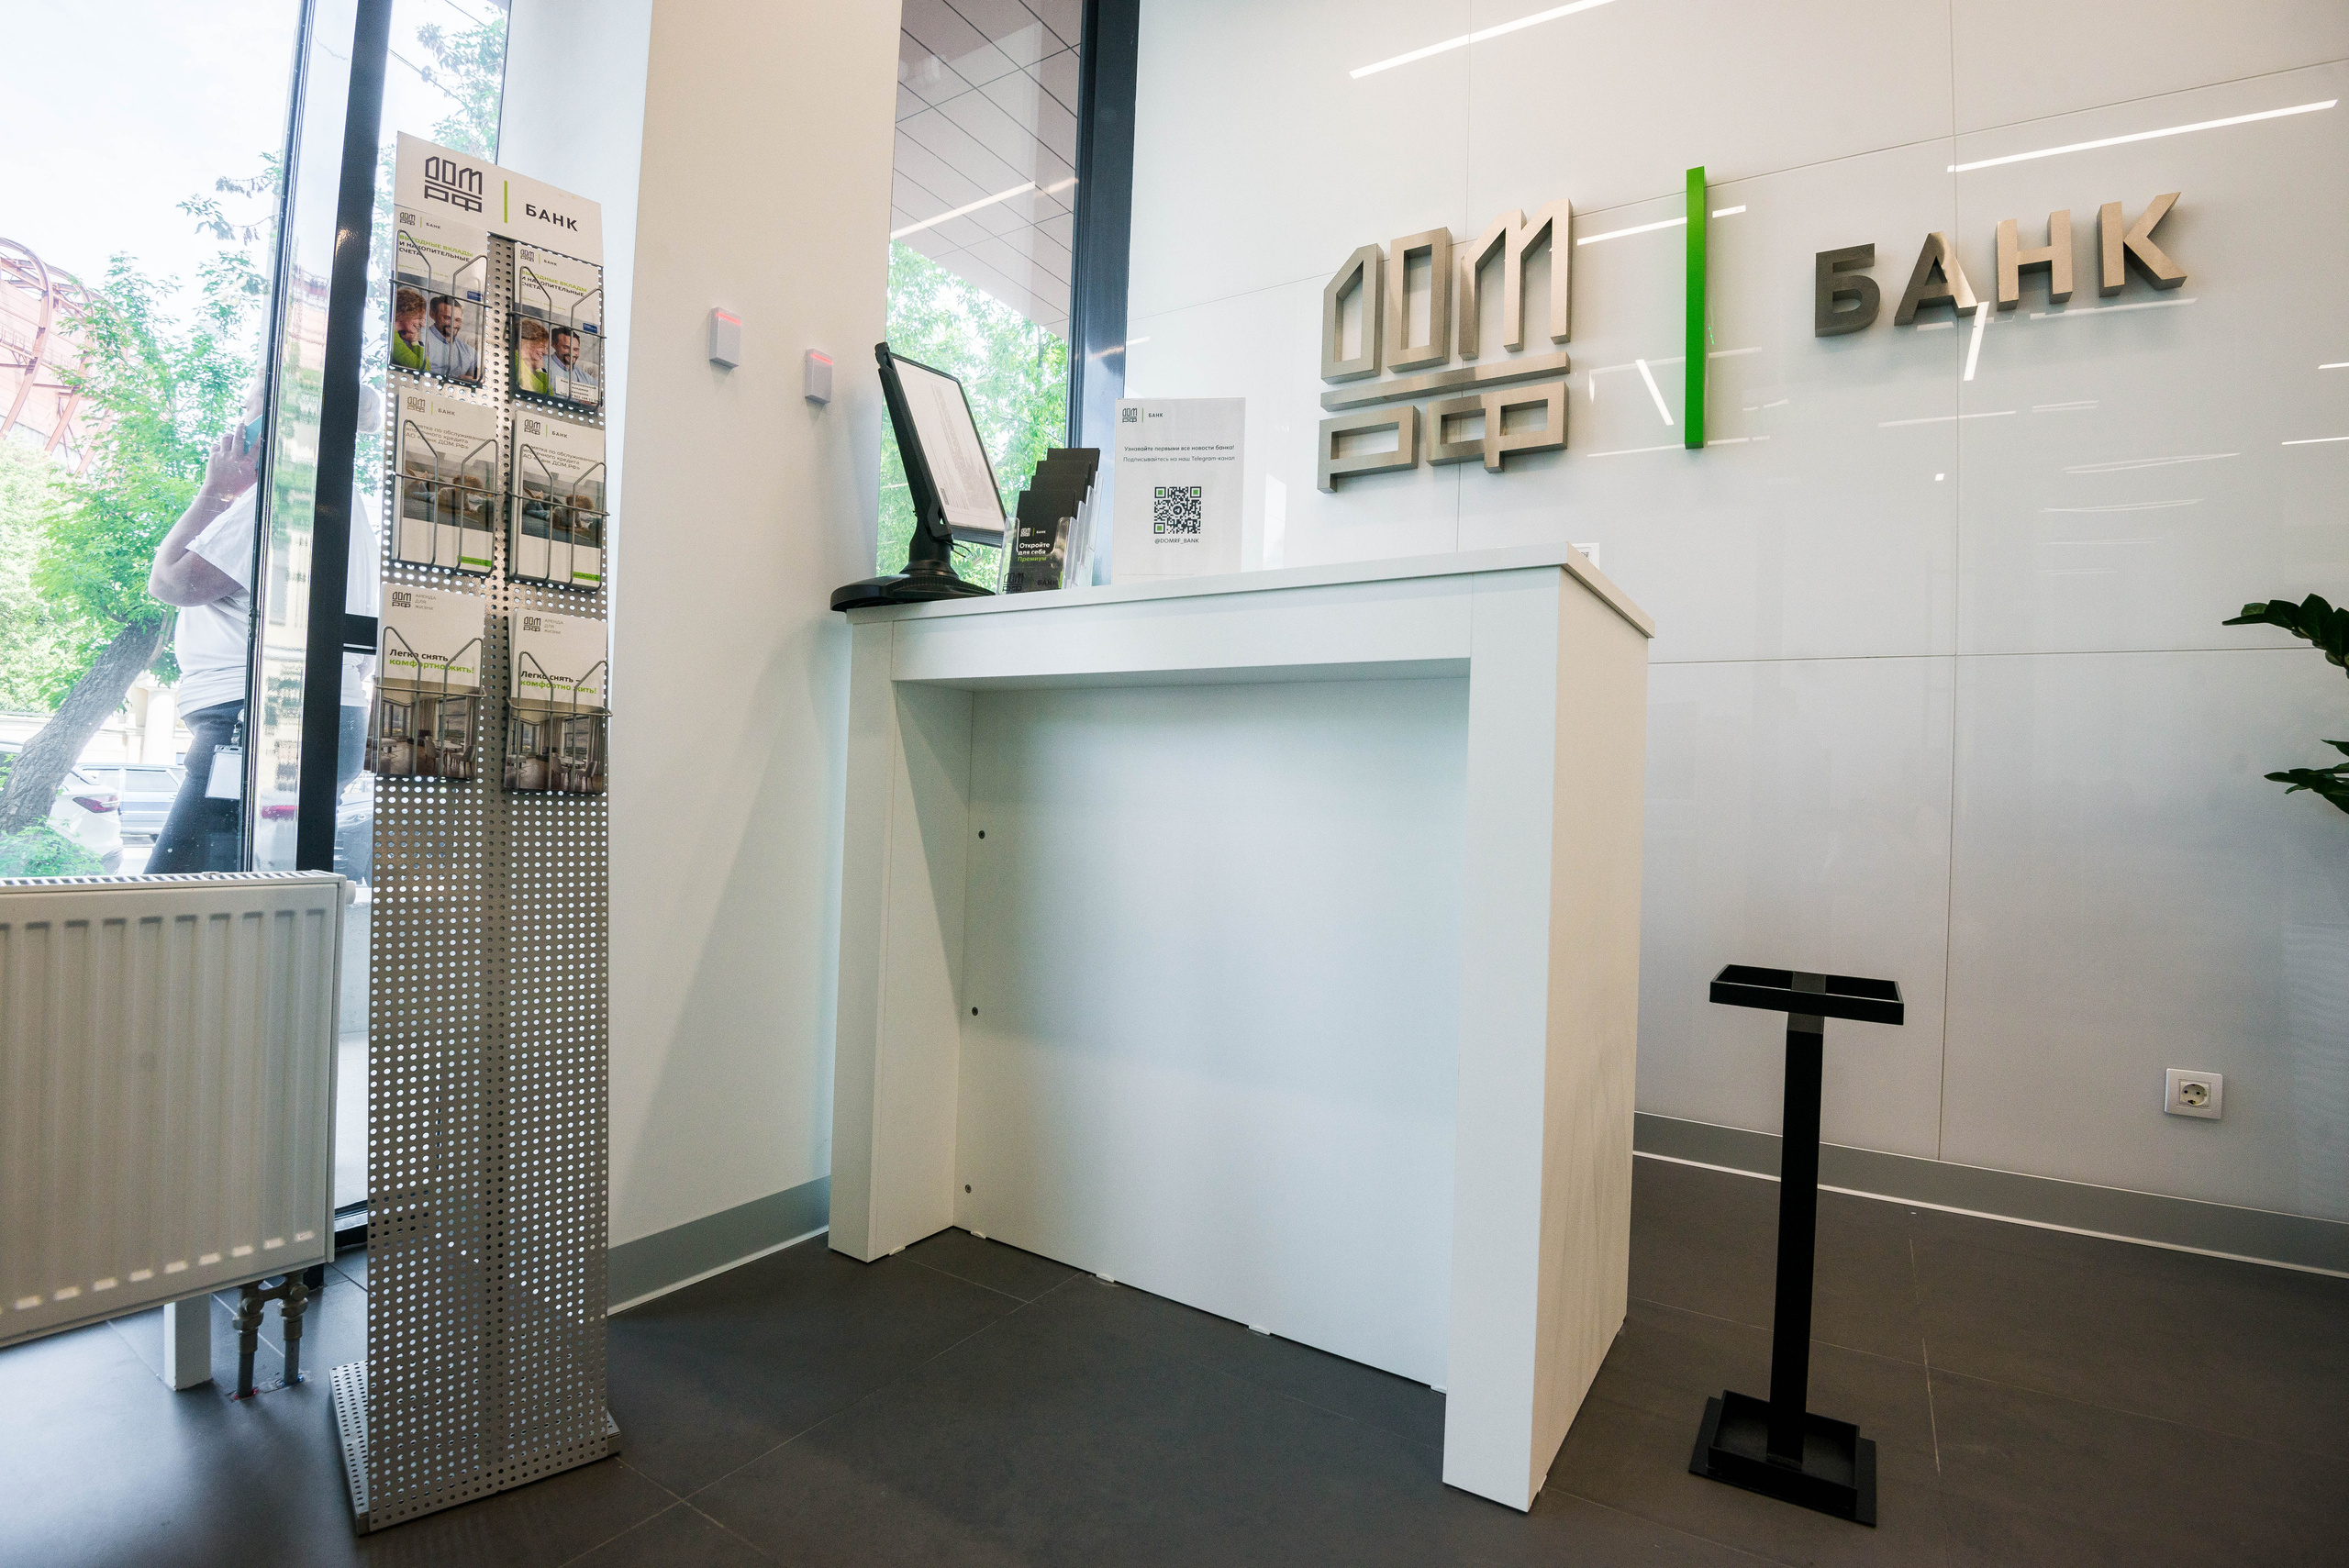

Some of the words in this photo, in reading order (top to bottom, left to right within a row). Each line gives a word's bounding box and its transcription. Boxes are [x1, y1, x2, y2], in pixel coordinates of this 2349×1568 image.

[425, 155, 483, 195] ДОМ
[424, 184, 483, 213] РФ
[525, 203, 578, 232] БАНК
[442, 245, 473, 258] ВКЛАДЫ
[1814, 190, 2188, 339] БАНК
[521, 270, 559, 285] ВЫОДНЫЕ
[559, 281, 587, 293] ВКЛАДЫ
[527, 277, 586, 298] НАОПИТЕЛЬНЫЕ
[1319, 197, 1574, 385] ДОМ
[438, 407, 456, 417] БАНК
[406, 427, 441, 439] ипоечного
[443, 435, 469, 446] кредита
[551, 430, 568, 439] БАНК
[1316, 381, 1569, 495] РФ
[522, 449, 556, 460] ипоечного
[556, 456, 580, 465] кредита
[1019, 541, 1051, 550] Откройте
[392, 591, 412, 602] ДОМ
[523, 616, 541, 627] ДОМ
[421, 652, 449, 662] снять
[447, 666, 475, 674] жить!
[520, 670, 548, 680] Легко
[549, 674, 574, 684] снять
